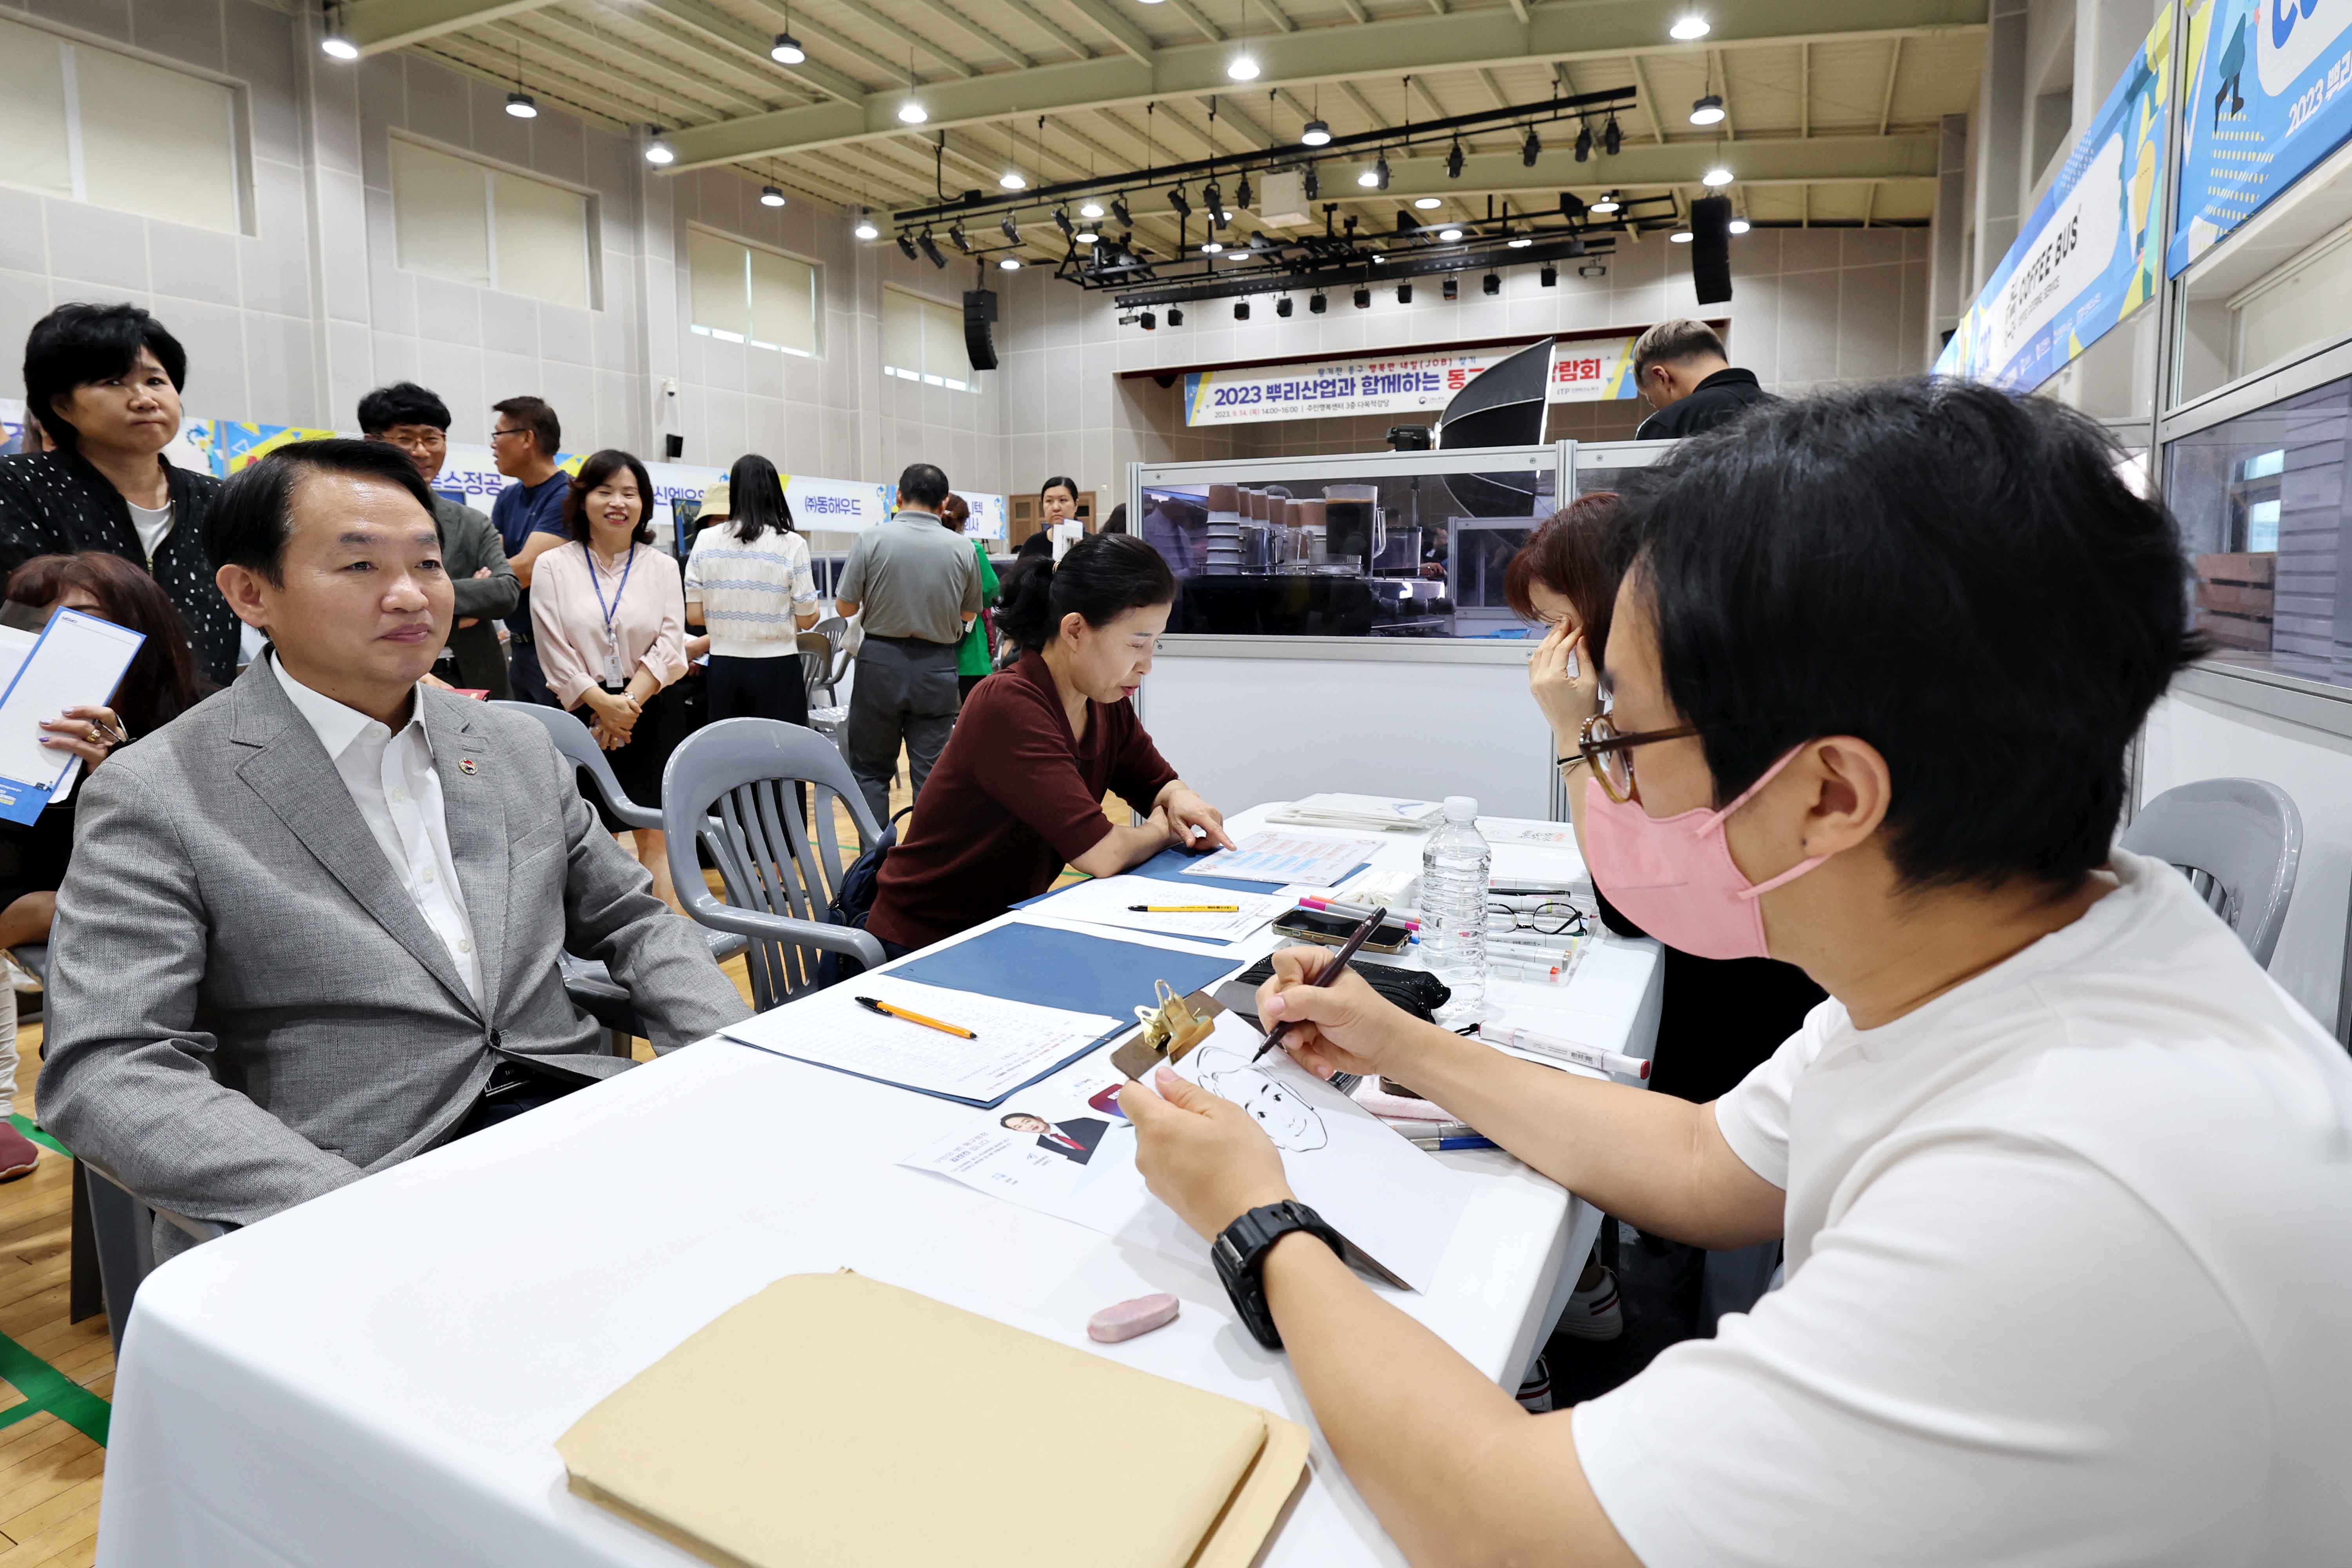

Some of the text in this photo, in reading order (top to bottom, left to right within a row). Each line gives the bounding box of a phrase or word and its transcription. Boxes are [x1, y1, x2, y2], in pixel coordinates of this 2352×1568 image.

[2285, 78, 2324, 138] 2023
[2055, 215, 2078, 267] BUS
[1214, 386, 1262, 406] 2023
[1266, 377, 1356, 402] 뿌리산업과
[1361, 371, 1441, 396] 함께하는
[1447, 367, 1485, 390] 동
[1368, 363, 1395, 372] 행복한
[1400, 358, 1453, 370] 내일(JOB)
